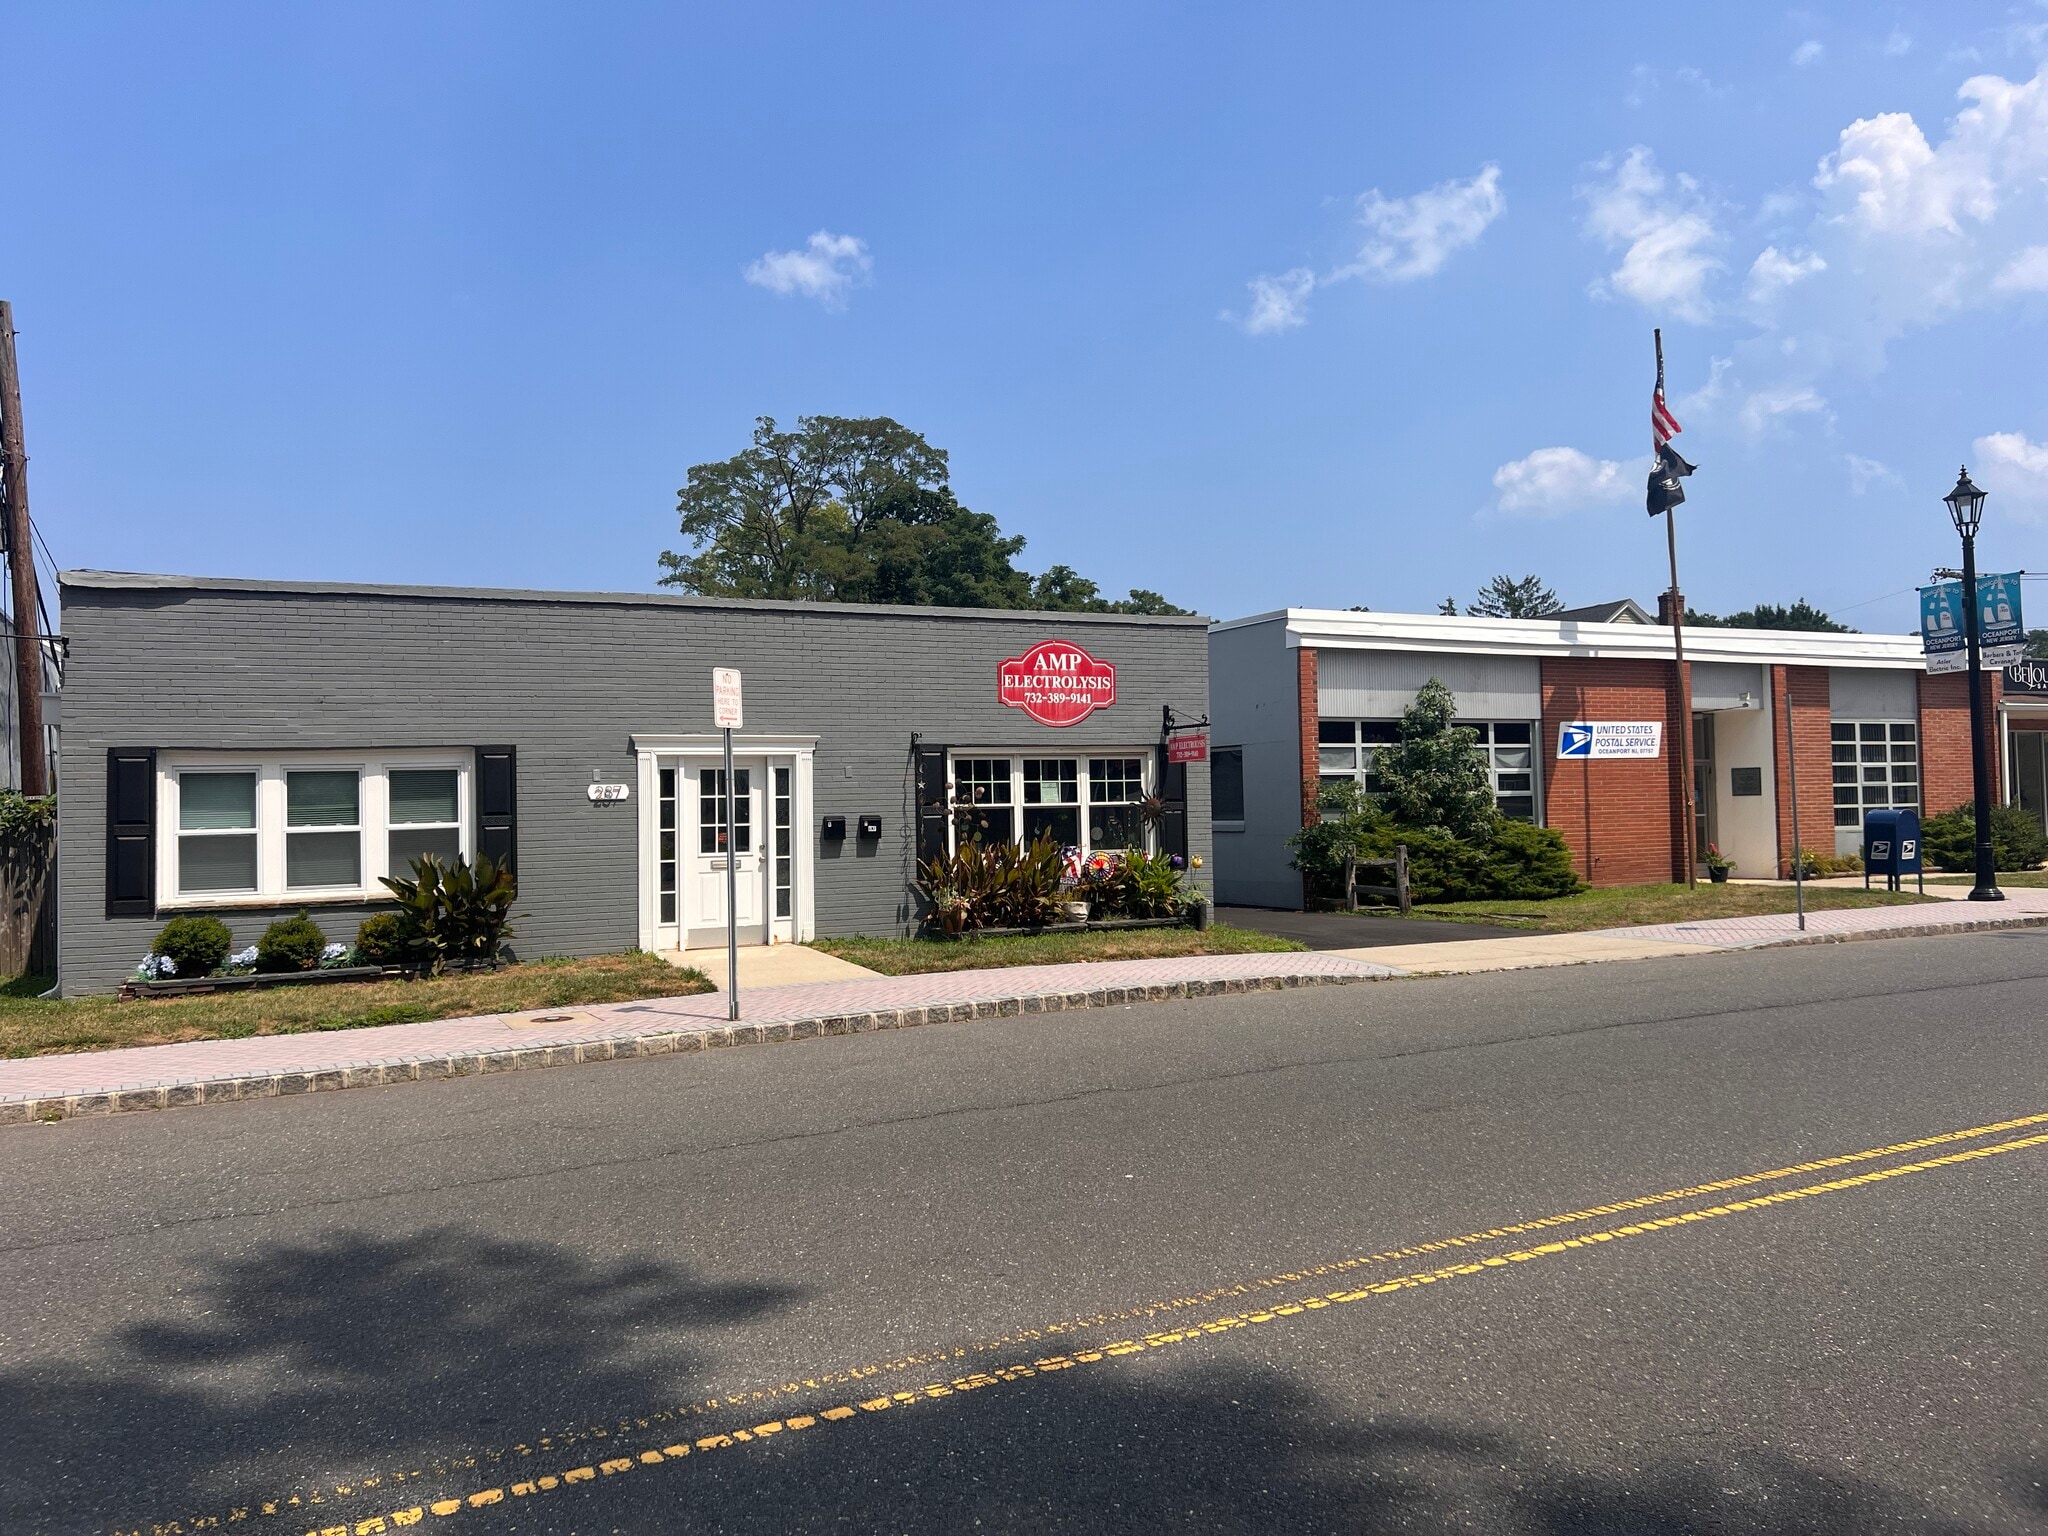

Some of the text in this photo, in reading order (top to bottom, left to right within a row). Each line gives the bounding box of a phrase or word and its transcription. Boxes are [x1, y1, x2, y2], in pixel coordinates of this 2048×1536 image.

[1982, 628, 2020, 639] OCEANPORT
[1926, 636, 1961, 645] OCEANPORT
[1033, 653, 1082, 671] AMP
[723, 674, 732, 684] NO
[1003, 675, 1111, 690] ELECTROLYSIS
[716, 685, 739, 697] PARKING
[1024, 692, 1092, 704] 732-389-9141
[1596, 725, 1653, 734] UNITED STATES
[1595, 738, 1656, 747] POSTAL SERVICE
[594, 786, 622, 800] 287
